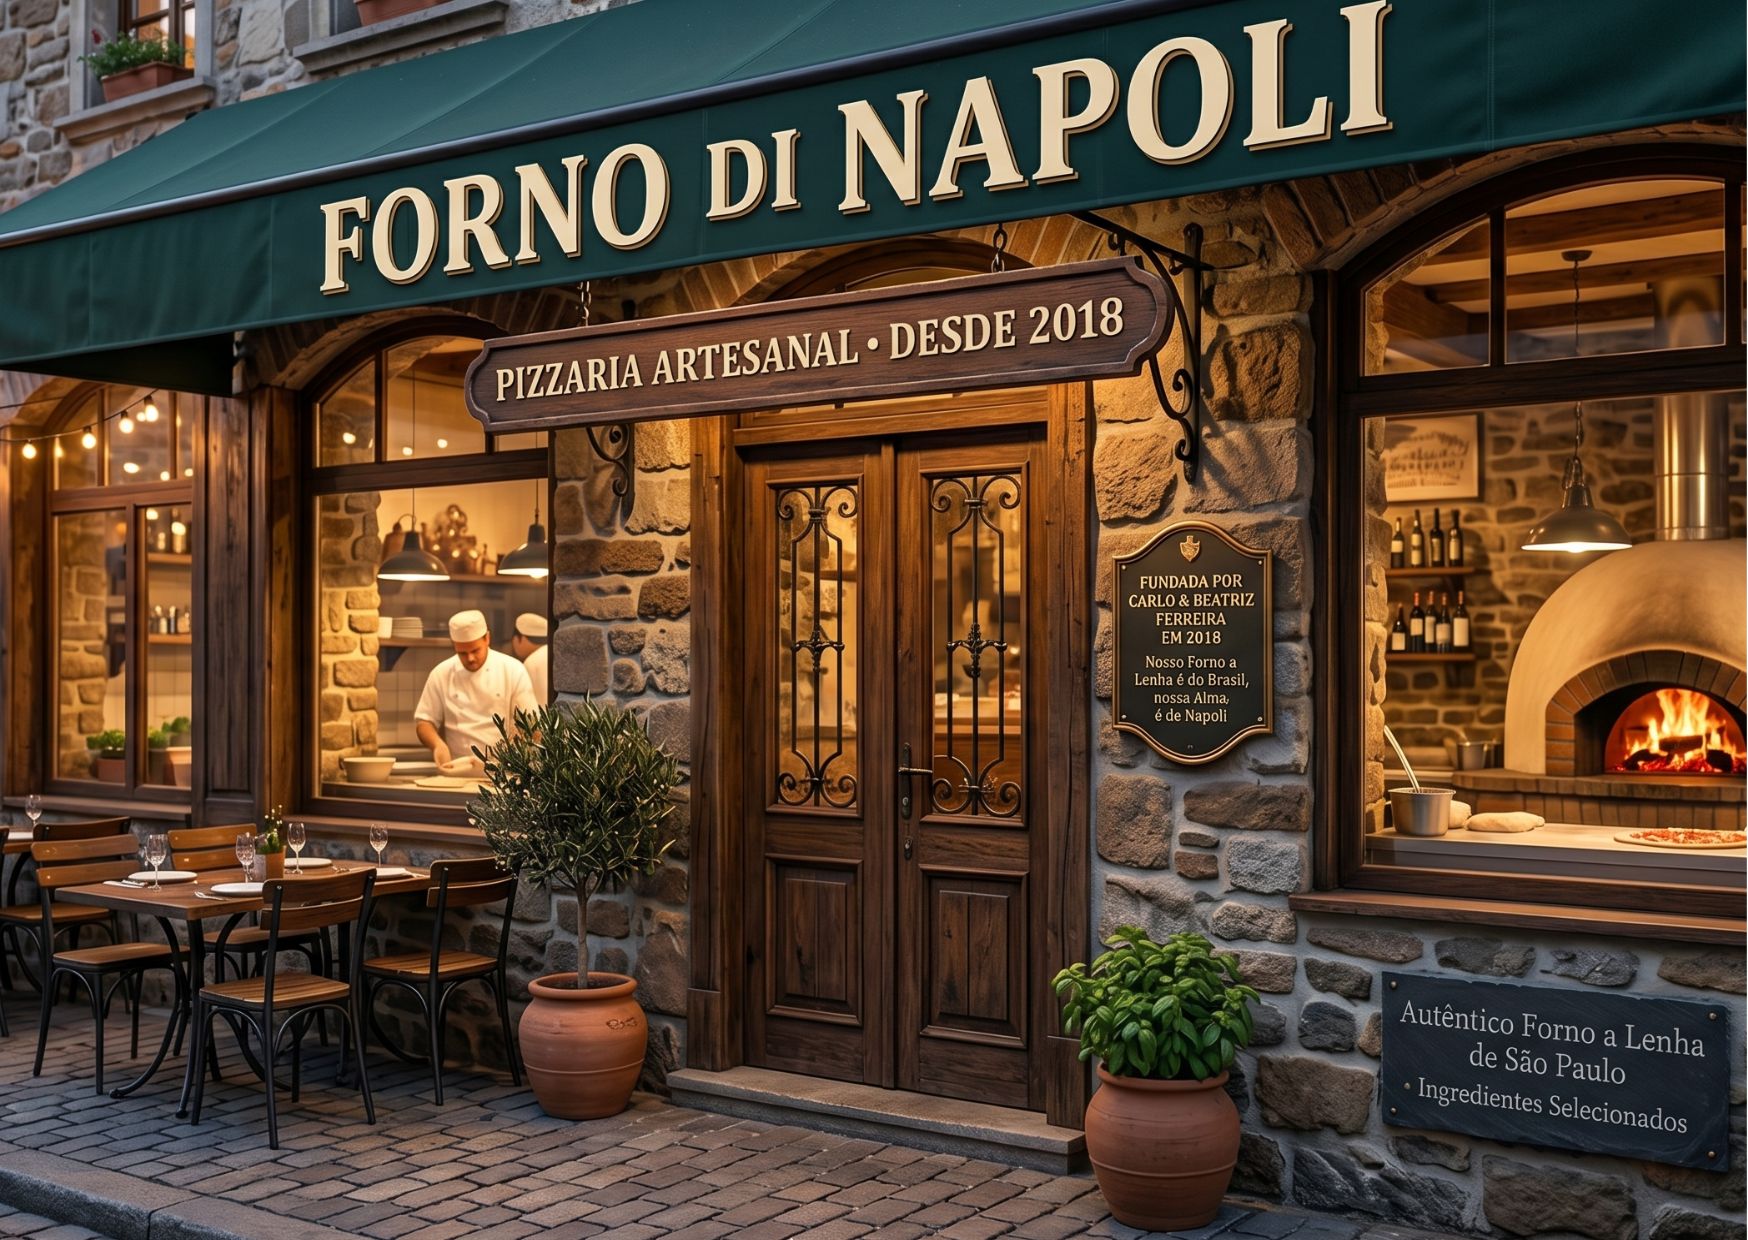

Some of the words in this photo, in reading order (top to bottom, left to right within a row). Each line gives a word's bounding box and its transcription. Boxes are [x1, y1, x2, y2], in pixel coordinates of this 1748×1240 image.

[320, 143, 669, 294] FORNO
[706, 129, 801, 220] DI
[838, 0, 1392, 213] NAPOLI
[496, 352, 645, 402] PIZZARIA
[651, 328, 860, 386] ARTESANAL
[889, 314, 1016, 361] DESDE
[1030, 297, 1124, 346] 2018
[1140, 575, 1209, 590] FUNDADA
[1213, 573, 1243, 588] POR
[1128, 594, 1176, 608] CARLO
[1178, 593, 1190, 607] &
[1194, 592, 1255, 607] BEATRIZ
[1156, 612, 1227, 626] FERREIRA
[1162, 630, 1182, 645] EM
[1186, 630, 1222, 645] 2018
[1145, 655, 1184, 669] Nosso
[1187, 655, 1226, 669] Forno
[1229, 658, 1237, 669] a
[1134, 672, 1173, 687] Lenha
[1176, 673, 1184, 686] é
[1188, 672, 1204, 686] do
[1208, 672, 1249, 689] Brasil,
[1154, 694, 1190, 704] nossa
[1155, 708, 1162, 722] é
[1166, 708, 1182, 722] de
[1185, 708, 1227, 726] Napoli
[1400, 999, 1514, 1035] Autêntico
[1522, 1012, 1595, 1045] Forno
[1603, 1029, 1618, 1048] a
[1625, 1023, 1706, 1058] Lenha
[1469, 1041, 1498, 1069] de
[1505, 1046, 1548, 1075] São
[1556, 1052, 1626, 1085] Paulo
[1418, 1076, 1543, 1114] Ingredientes
[1549, 1094, 1688, 1134] Selecionados
